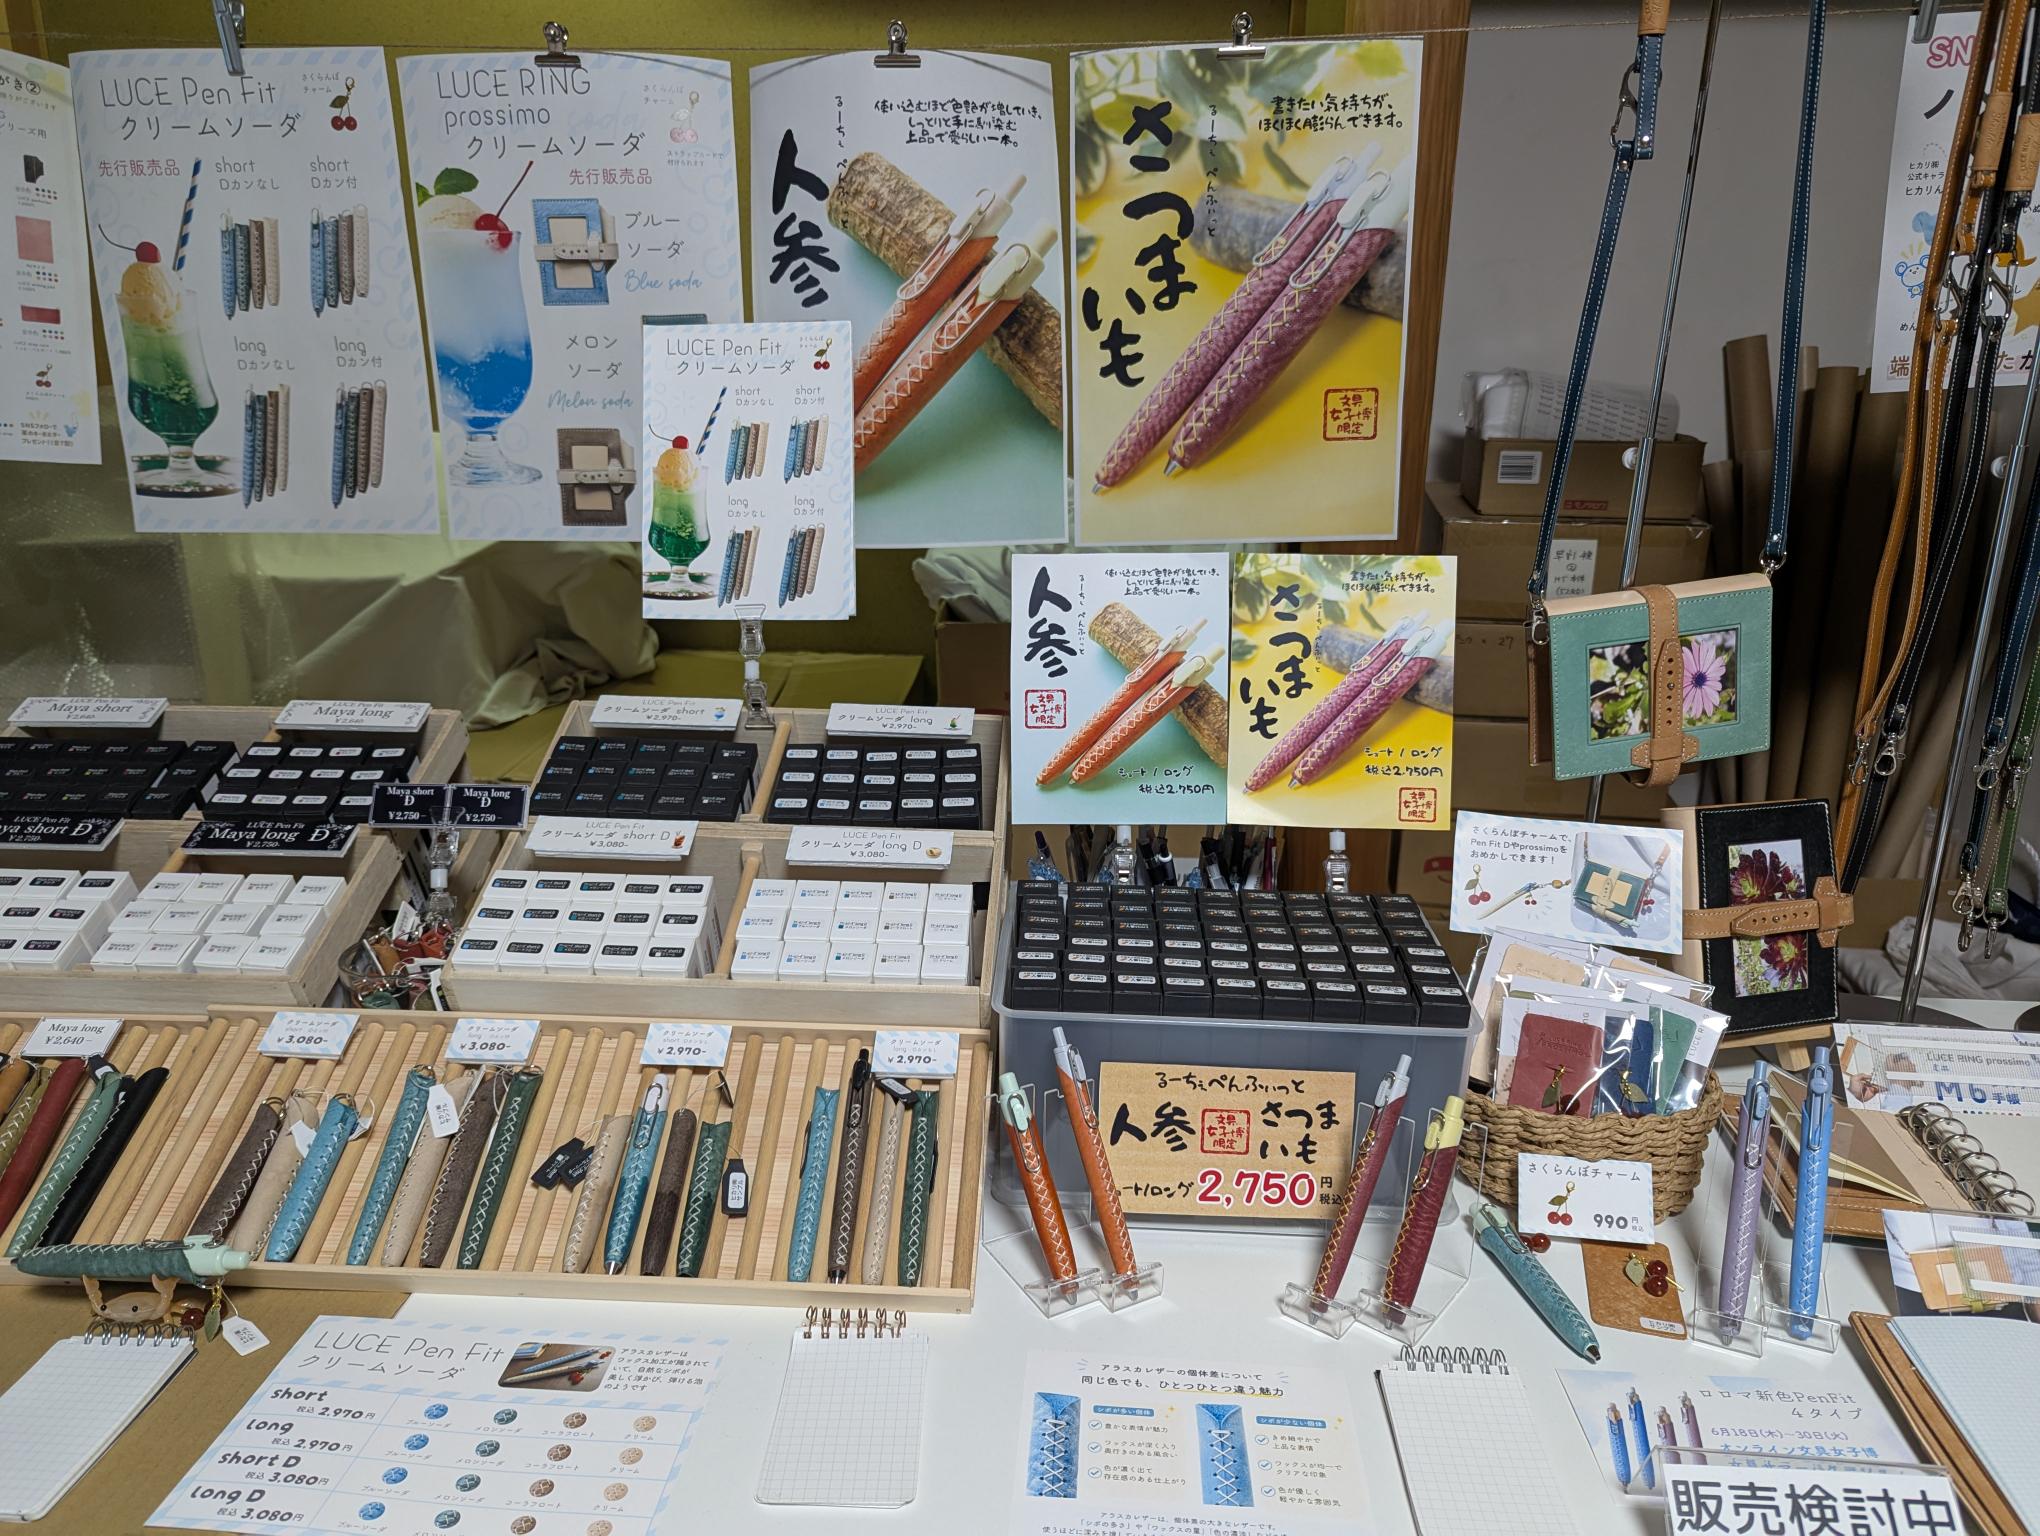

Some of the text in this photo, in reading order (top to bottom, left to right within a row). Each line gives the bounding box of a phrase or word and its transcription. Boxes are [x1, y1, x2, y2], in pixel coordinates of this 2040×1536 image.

[101, 76, 275, 107] LUCE Pen Fit
[437, 68, 590, 99] LUCE RING
[122, 112, 301, 140] クリームソーダ
[445, 106, 550, 134] prossimo
[467, 132, 646, 159] クリームソーダ
[98, 159, 180, 177] 先行販売品
[215, 156, 256, 174] short
[310, 157, 351, 174] short
[219, 178, 280, 191] Dカンなし
[311, 177, 358, 190] Dカン付
[569, 168, 652, 185] 先行販売品
[625, 212, 681, 230] ブルー
[769, 129, 841, 308] 人参
[627, 240, 685, 258] ソーダ
[625, 271, 703, 290] Blue soda
[234, 336, 267, 356] long
[335, 336, 367, 357] long
[566, 334, 619, 350] メロン
[667, 338, 782, 356] LUCE Pen Fit
[238, 359, 296, 372] Dカンなし
[336, 355, 383, 370] Dカン付
[568, 362, 623, 379] ソーダ
[676, 359, 796, 376] クリームソーダ
[735, 385, 761, 396] short
[795, 385, 820, 396] short
[548, 390, 634, 410] Melon soda
[728, 496, 750, 510] long
[794, 496, 816, 509] long
[1024, 566, 1077, 678] 人参
[48, 702, 134, 714] Maya short
[314, 706, 393, 719] Maya long
[603, 705, 706, 715] クリームソーダ short
[838, 713, 934, 726] クリームソーダ long
[387, 786, 435, 797] Maya short
[463, 787, 511, 800] Maya long
[24, 823, 70, 835] short
[208, 828, 300, 843] Maya long
[542, 829, 671, 840] クリームソーダ short D
[1471, 824, 1574, 843] さくらんぼチャームで、
[801, 839, 923, 852] クリームソーダ long D
[1470, 838, 1489, 849] Pen
[1489, 839, 1502, 849] Fit
[48, 1023, 106, 1035] Maya long
[1927, 1052, 1955, 1063] LUCE
[1986, 1057, 2032, 1068] prossimo
[1216, 1114, 1237, 1125] 文具
[1260, 1100, 1341, 1131] さつま
[1109, 1101, 1197, 1152] 人参
[1206, 1125, 1244, 1138] 女子博
[1213, 1138, 1237, 1150] 限定
[1259, 1133, 1318, 1164] いも
[1528, 1162, 1642, 1182] さくらんぼチャーム
[1198, 1169, 1316, 1208] 2,750
[1592, 1212, 1630, 1231] 990
[314, 1330, 506, 1364] LUCE Pen Fit
[298, 1354, 466, 1381] クリームソーダ
[1100, 1364, 1265, 1382] アラスカレザーの個体差について
[270, 1386, 329, 1403] short
[1791, 1407, 1864, 1420] 4タイプ
[246, 1418, 295, 1436] long
[217, 1450, 302, 1469] short D
[190, 1485, 267, 1503] long D
[1671, 1478, 1958, 1536] 販売検討中
